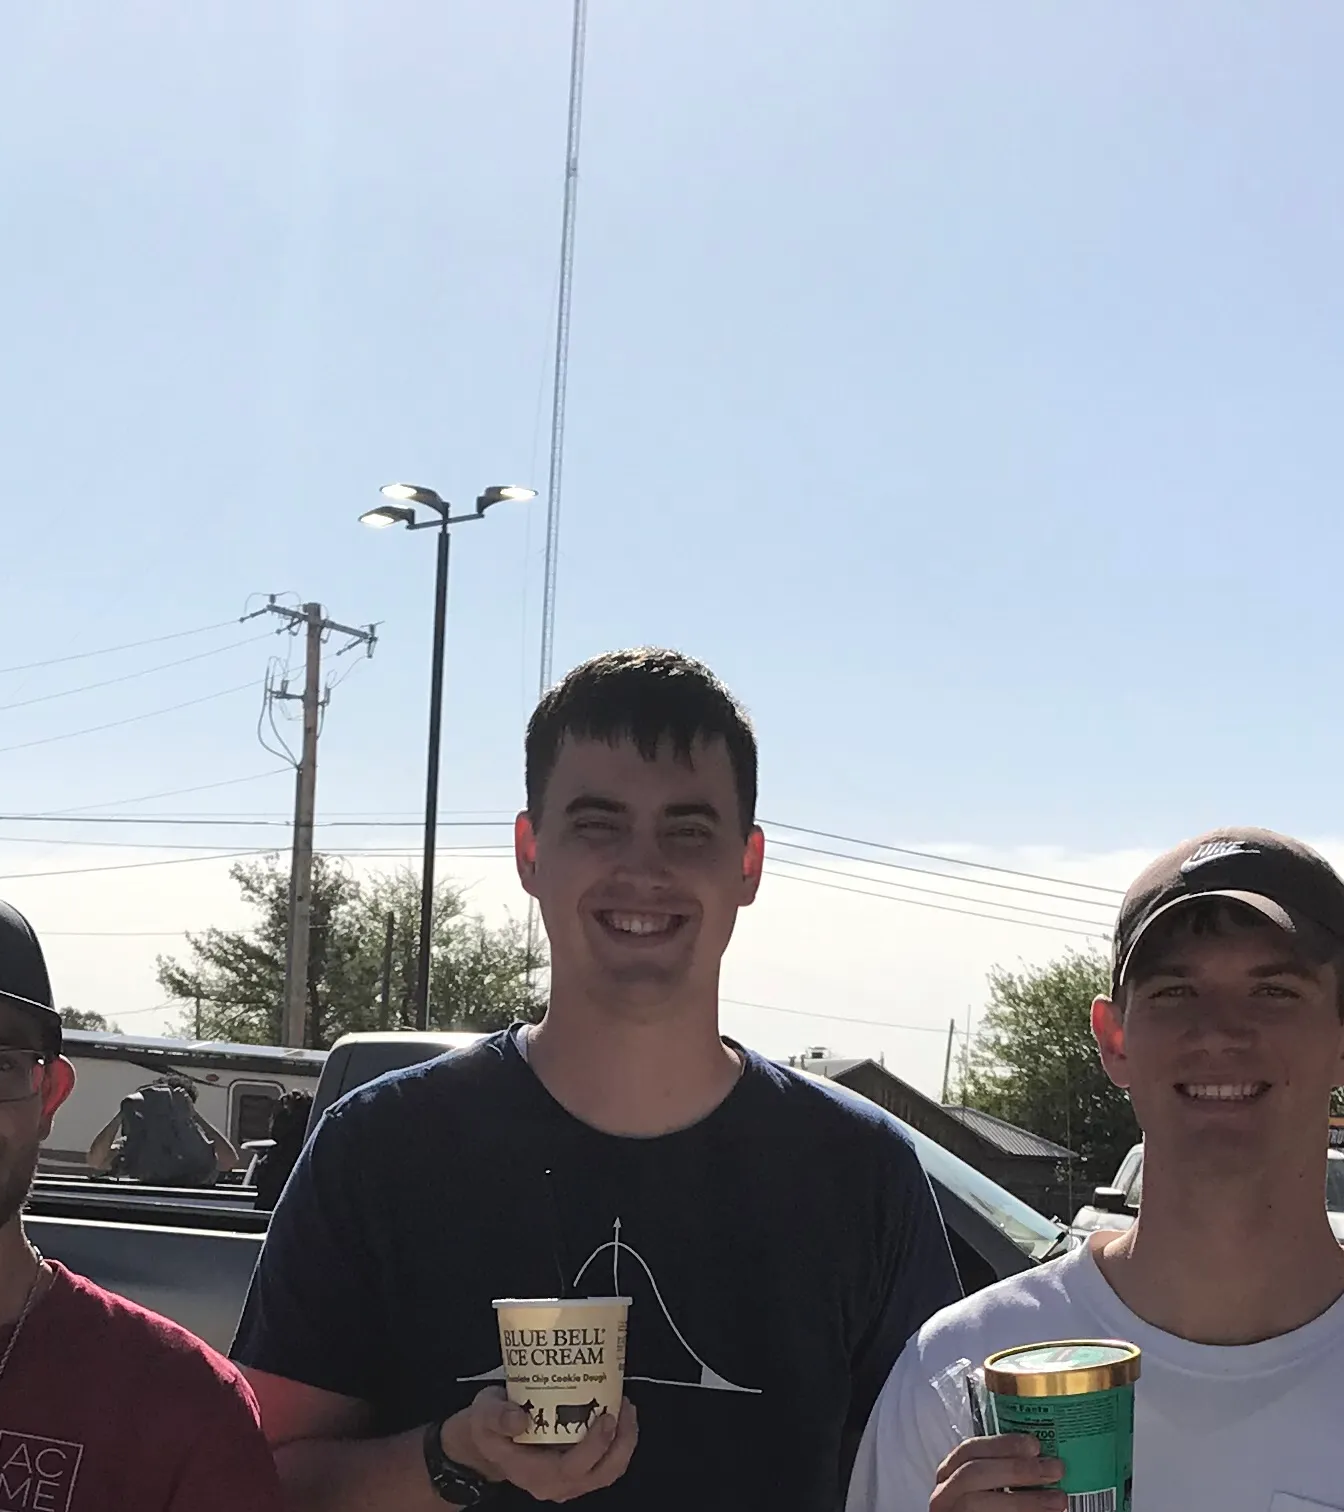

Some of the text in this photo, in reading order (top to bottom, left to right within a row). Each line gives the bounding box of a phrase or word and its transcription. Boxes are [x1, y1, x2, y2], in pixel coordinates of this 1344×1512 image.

[1193, 841, 1245, 859] NIKE
[504, 1328, 605, 1347] BLUE BELL
[506, 1347, 604, 1366] ICE CREAM
[532, 1374, 549, 1385] Chip
[551, 1373, 581, 1383] Cookie
